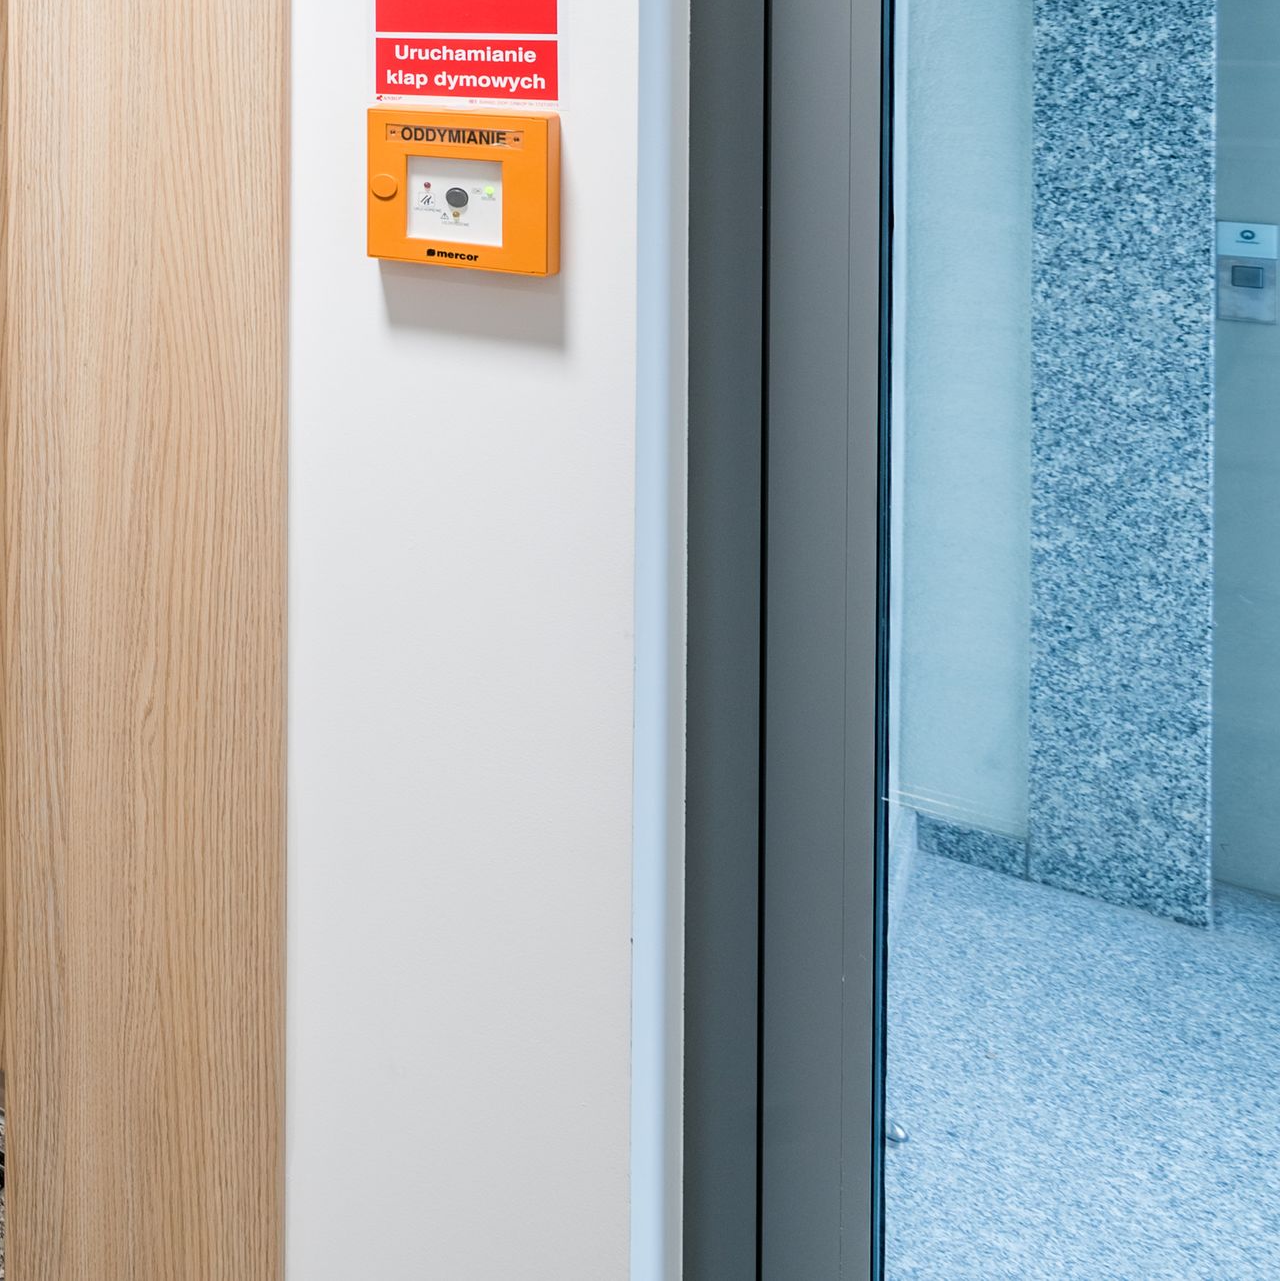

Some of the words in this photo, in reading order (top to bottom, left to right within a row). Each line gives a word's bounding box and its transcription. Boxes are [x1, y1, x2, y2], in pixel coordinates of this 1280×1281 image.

[394, 44, 537, 63] Uruchamianie
[386, 69, 429, 89] klap
[433, 71, 546, 93] dymowych
[400, 126, 508, 146] ODDYMIANIE
[436, 250, 479, 262] mercor
